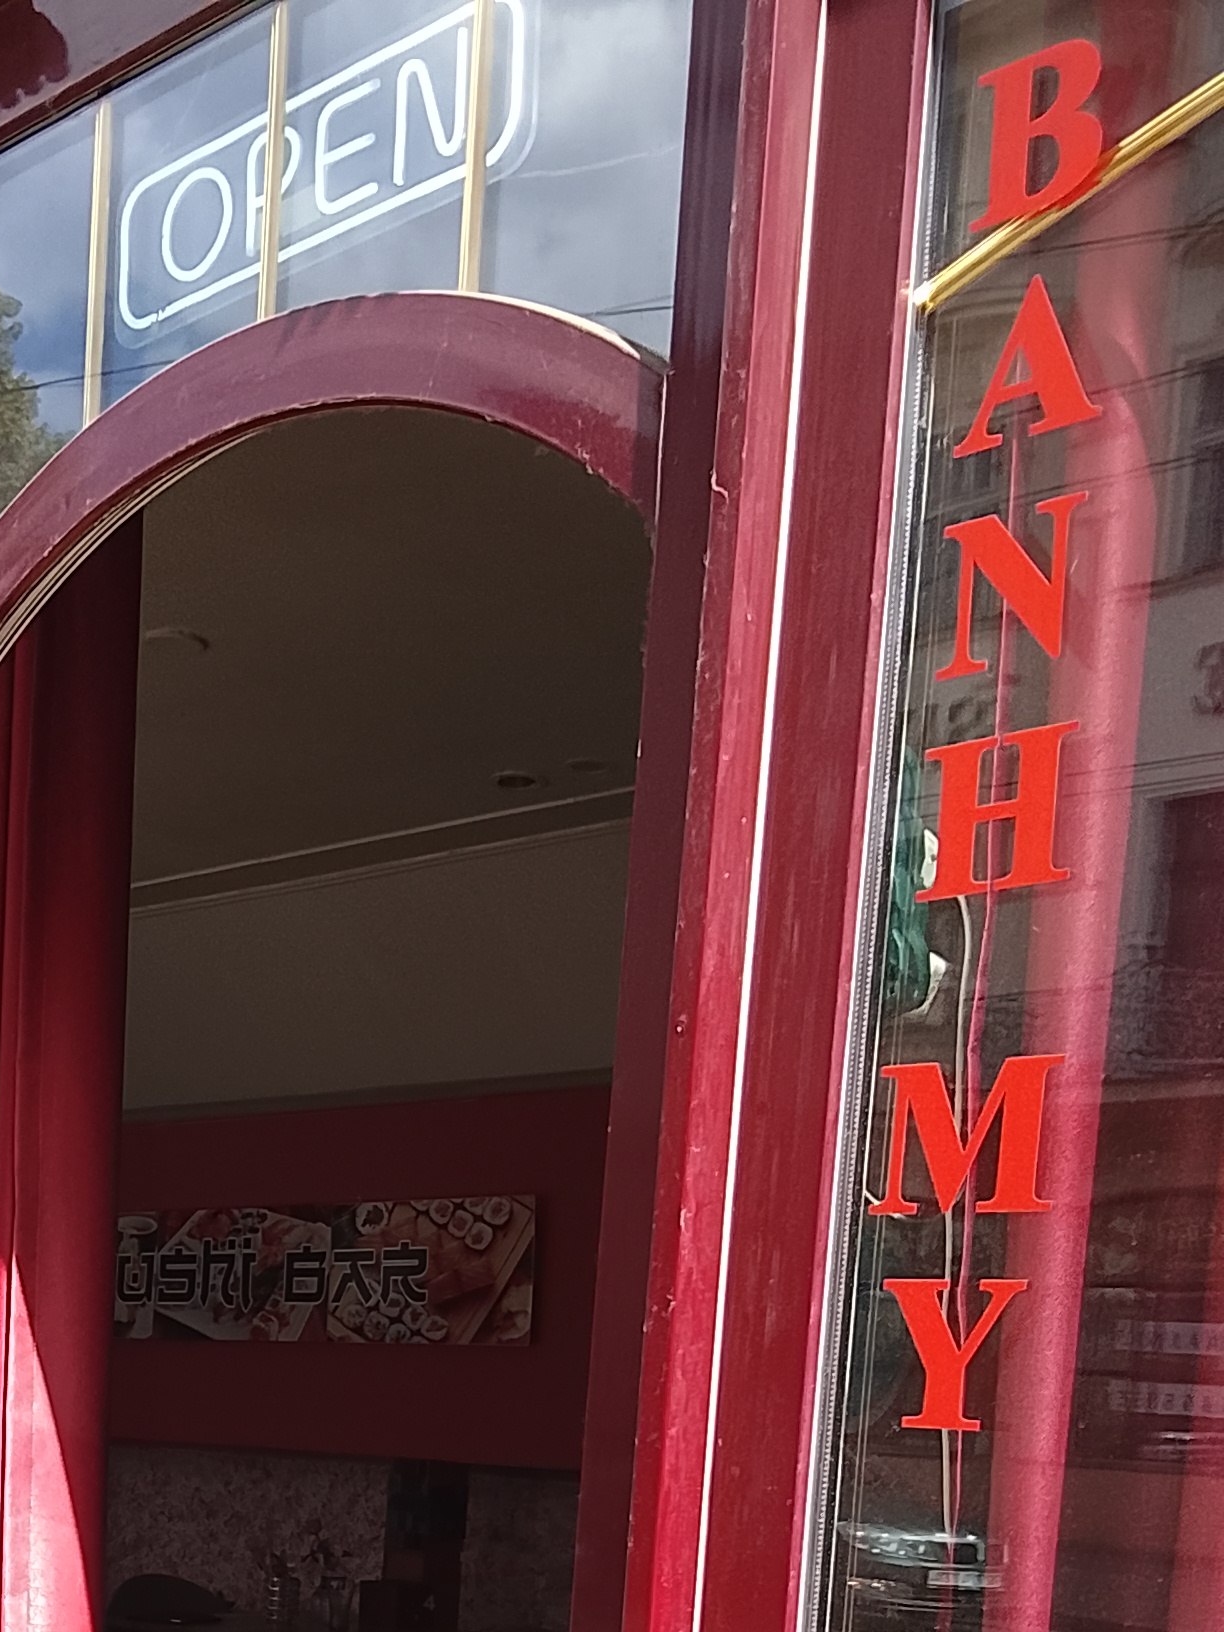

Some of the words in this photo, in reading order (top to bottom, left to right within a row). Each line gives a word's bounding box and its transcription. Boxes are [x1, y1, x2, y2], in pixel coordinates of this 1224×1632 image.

[162, 27, 468, 283] OPEN
[915, 38, 1104, 903] BANH
[868, 1053, 1066, 1432] MY
